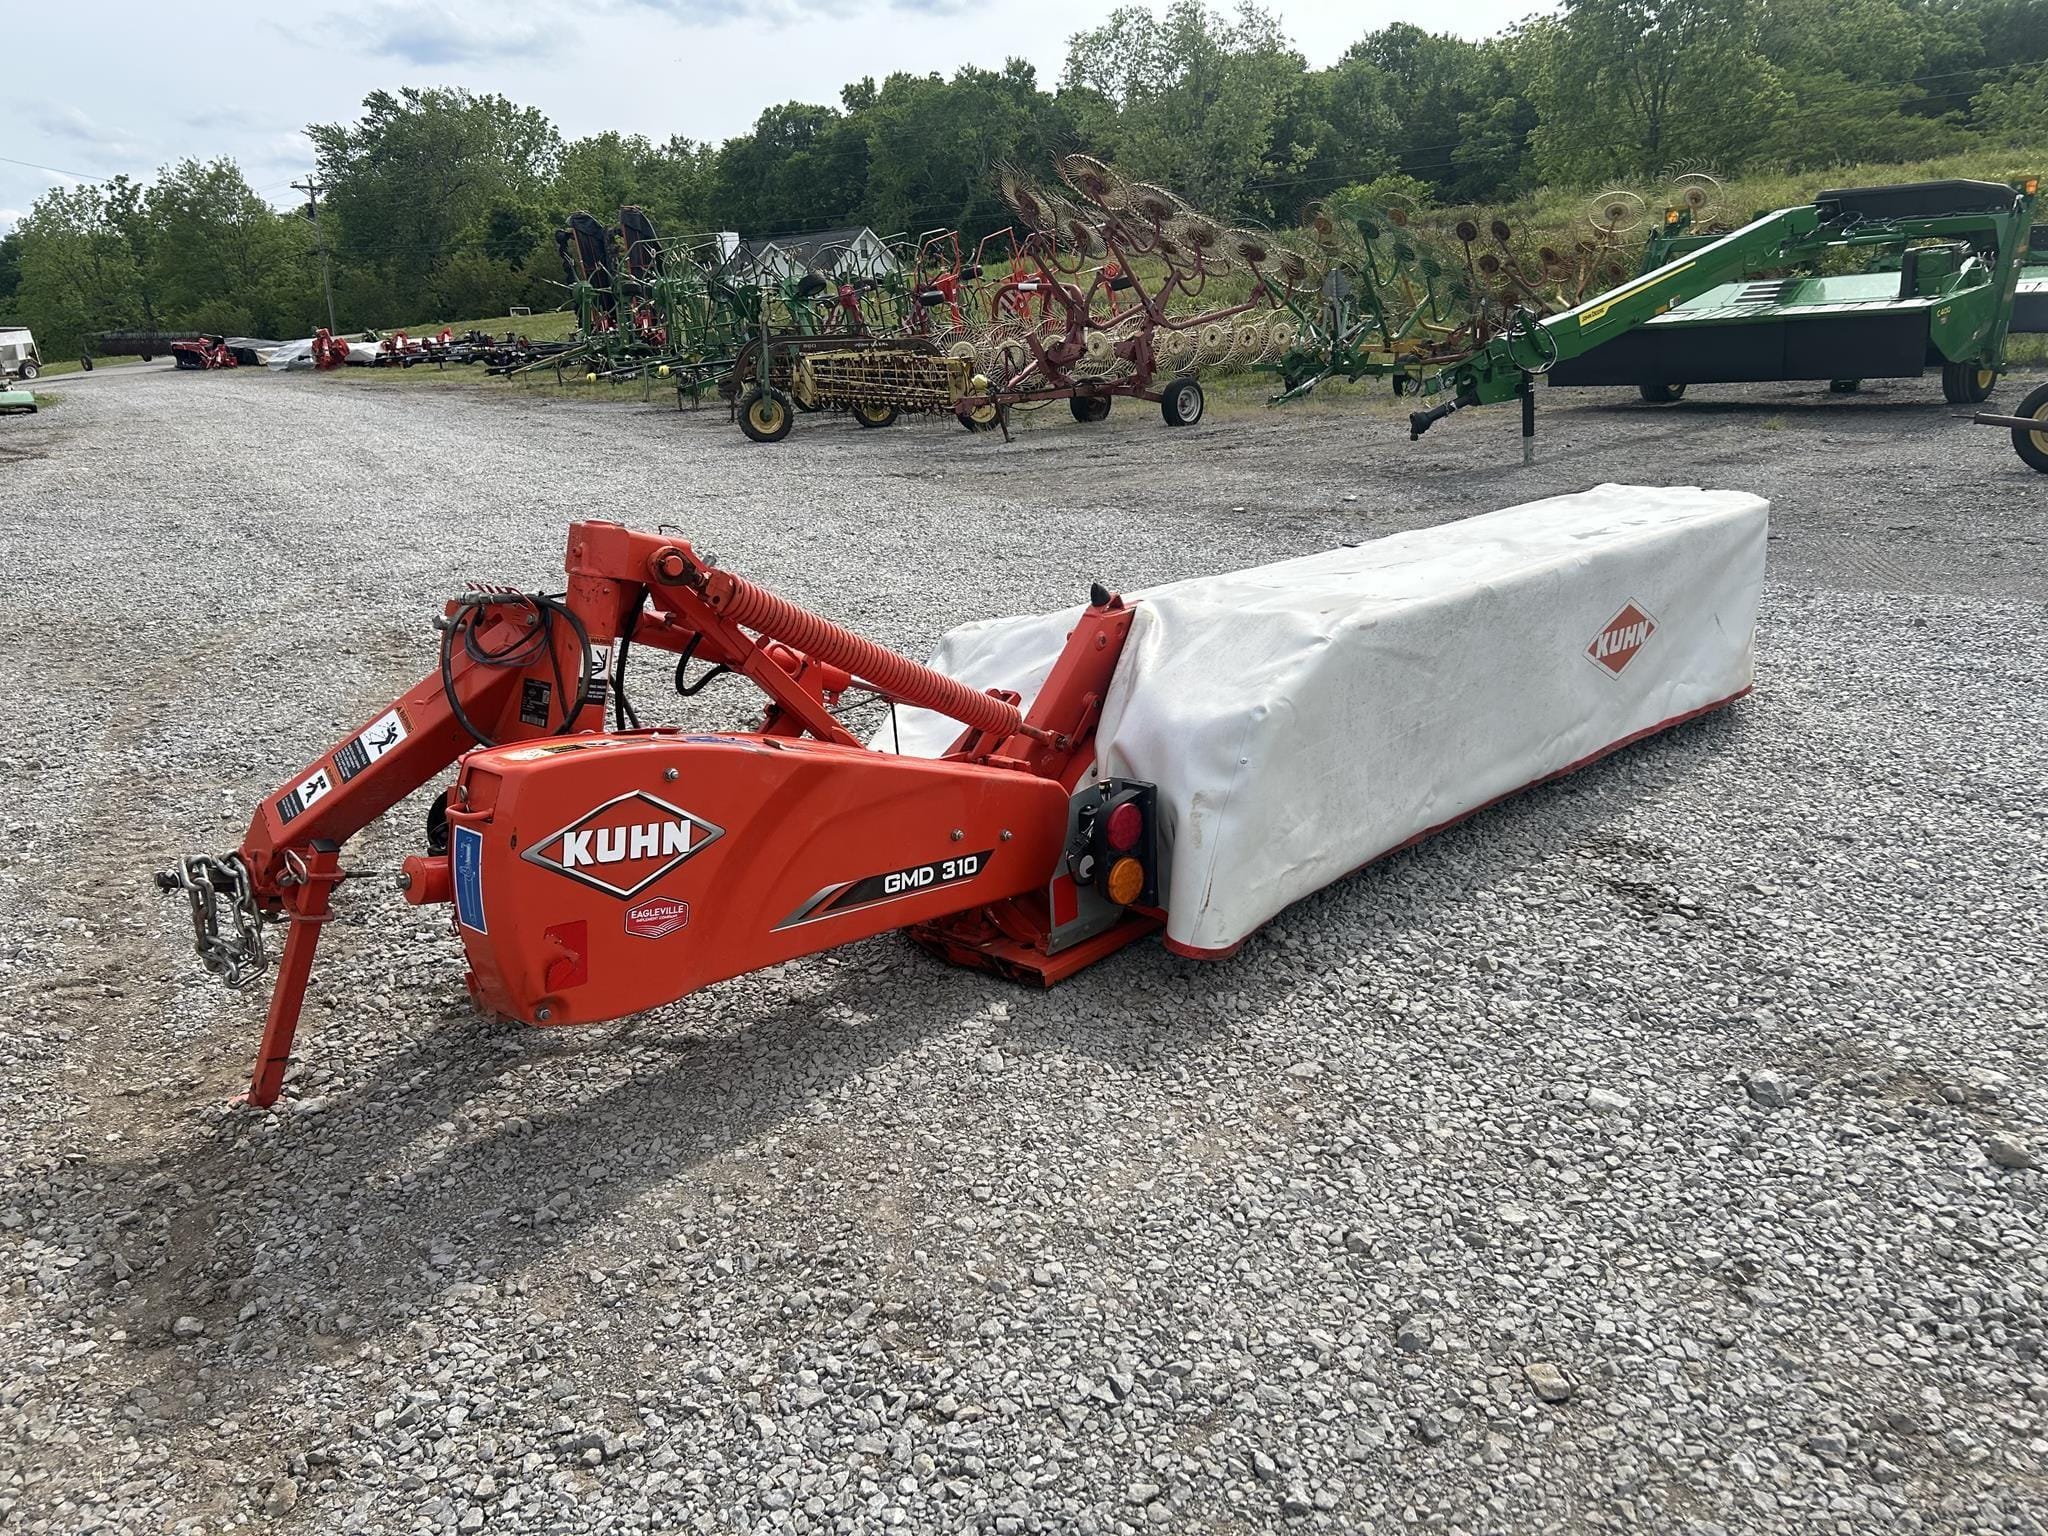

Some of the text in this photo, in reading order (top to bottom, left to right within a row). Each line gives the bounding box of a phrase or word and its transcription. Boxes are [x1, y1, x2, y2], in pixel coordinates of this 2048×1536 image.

[1595, 619, 1649, 659] KUHN
[562, 819, 691, 868] KUHN
[884, 855, 978, 894] GMD 310
[631, 905, 684, 919] EAGLEVILLE
